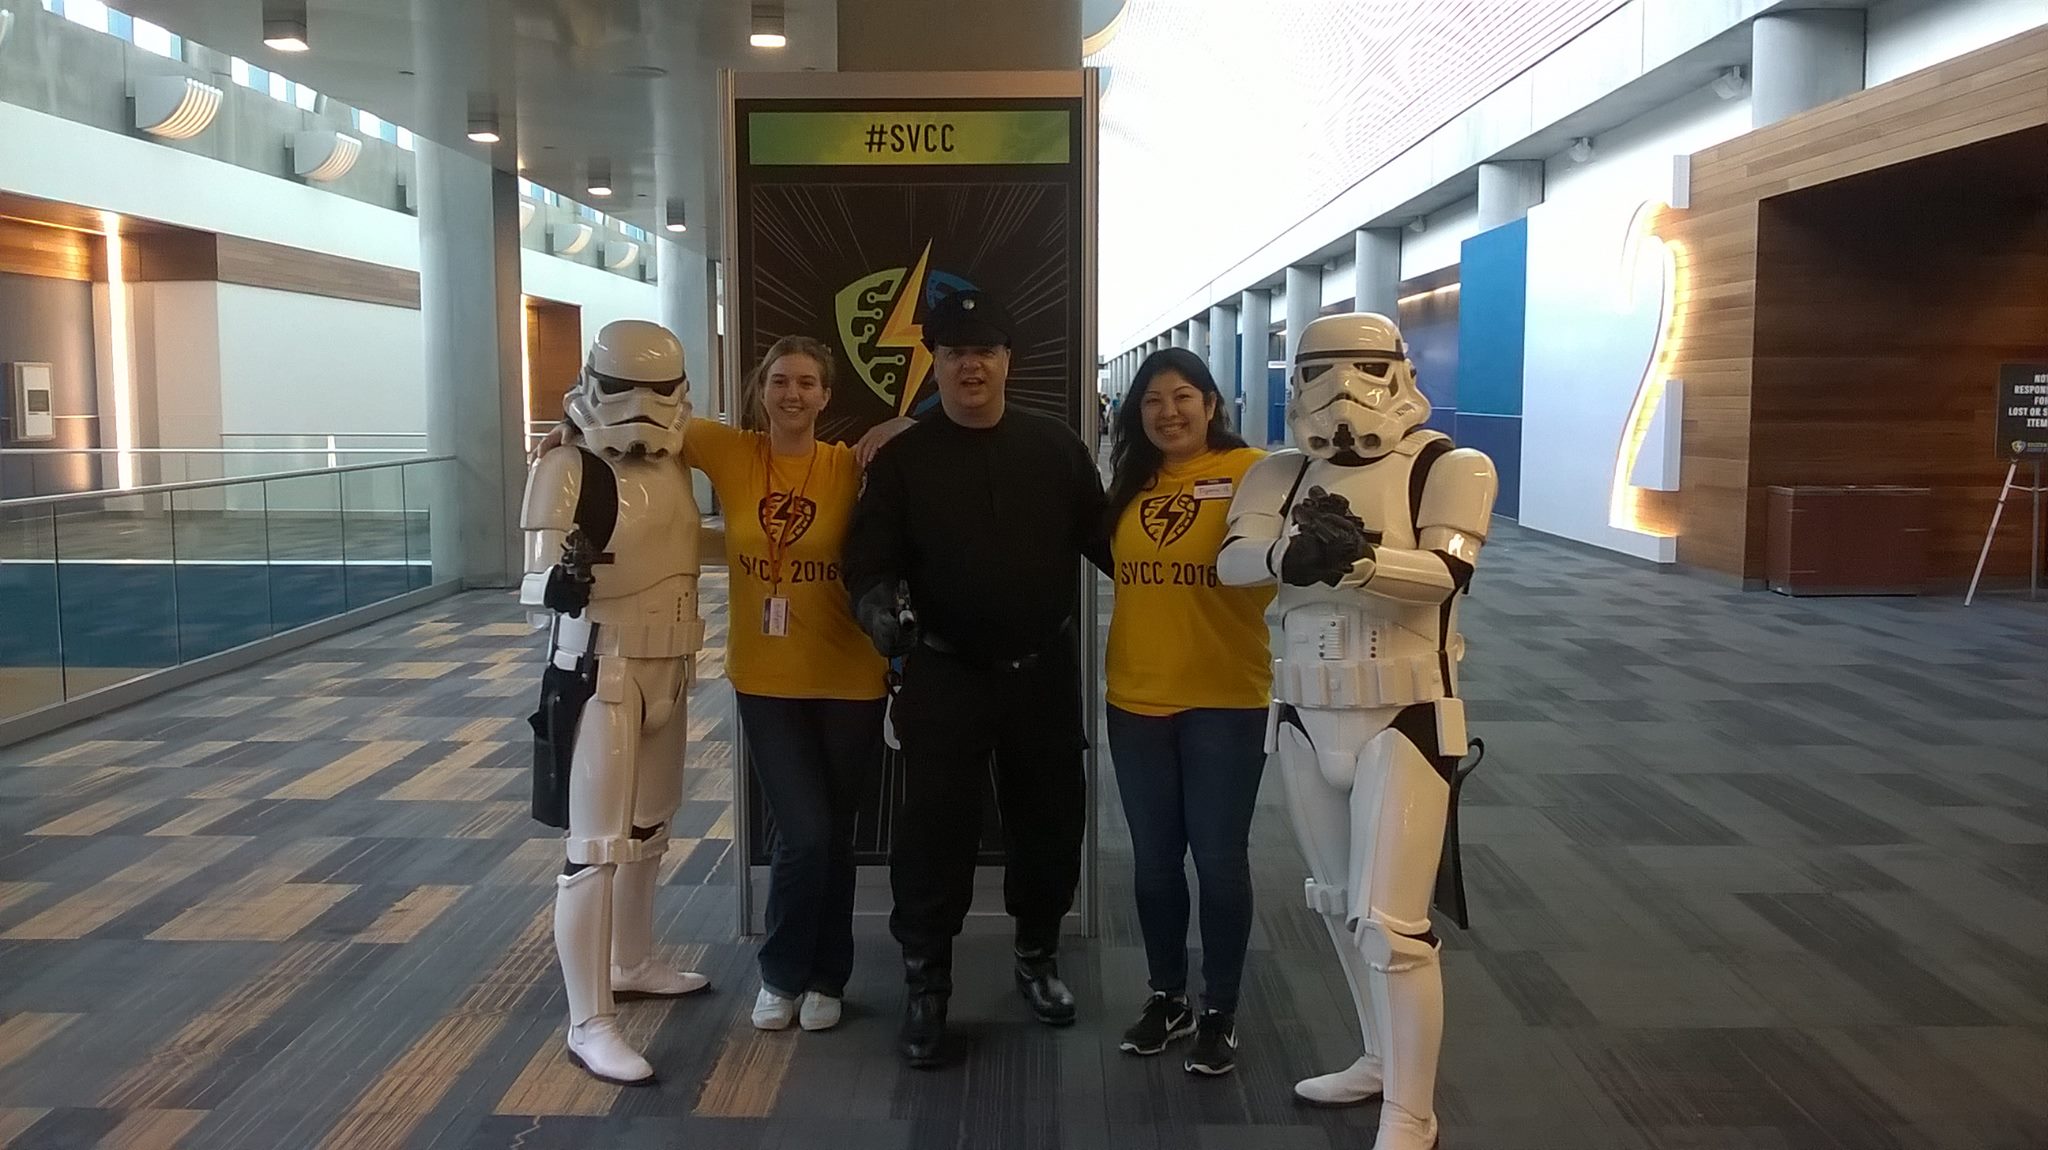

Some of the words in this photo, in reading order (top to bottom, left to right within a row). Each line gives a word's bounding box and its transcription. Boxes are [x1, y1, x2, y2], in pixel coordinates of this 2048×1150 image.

[864, 123, 955, 153] #SVCC
[2014, 384, 2048, 395] RESPON
[2008, 406, 2028, 416] LOST
[2029, 407, 2041, 417] OR
[791, 559, 839, 584] 2016
[1121, 561, 1164, 585] SVCC
[1171, 562, 1217, 588] 2016
